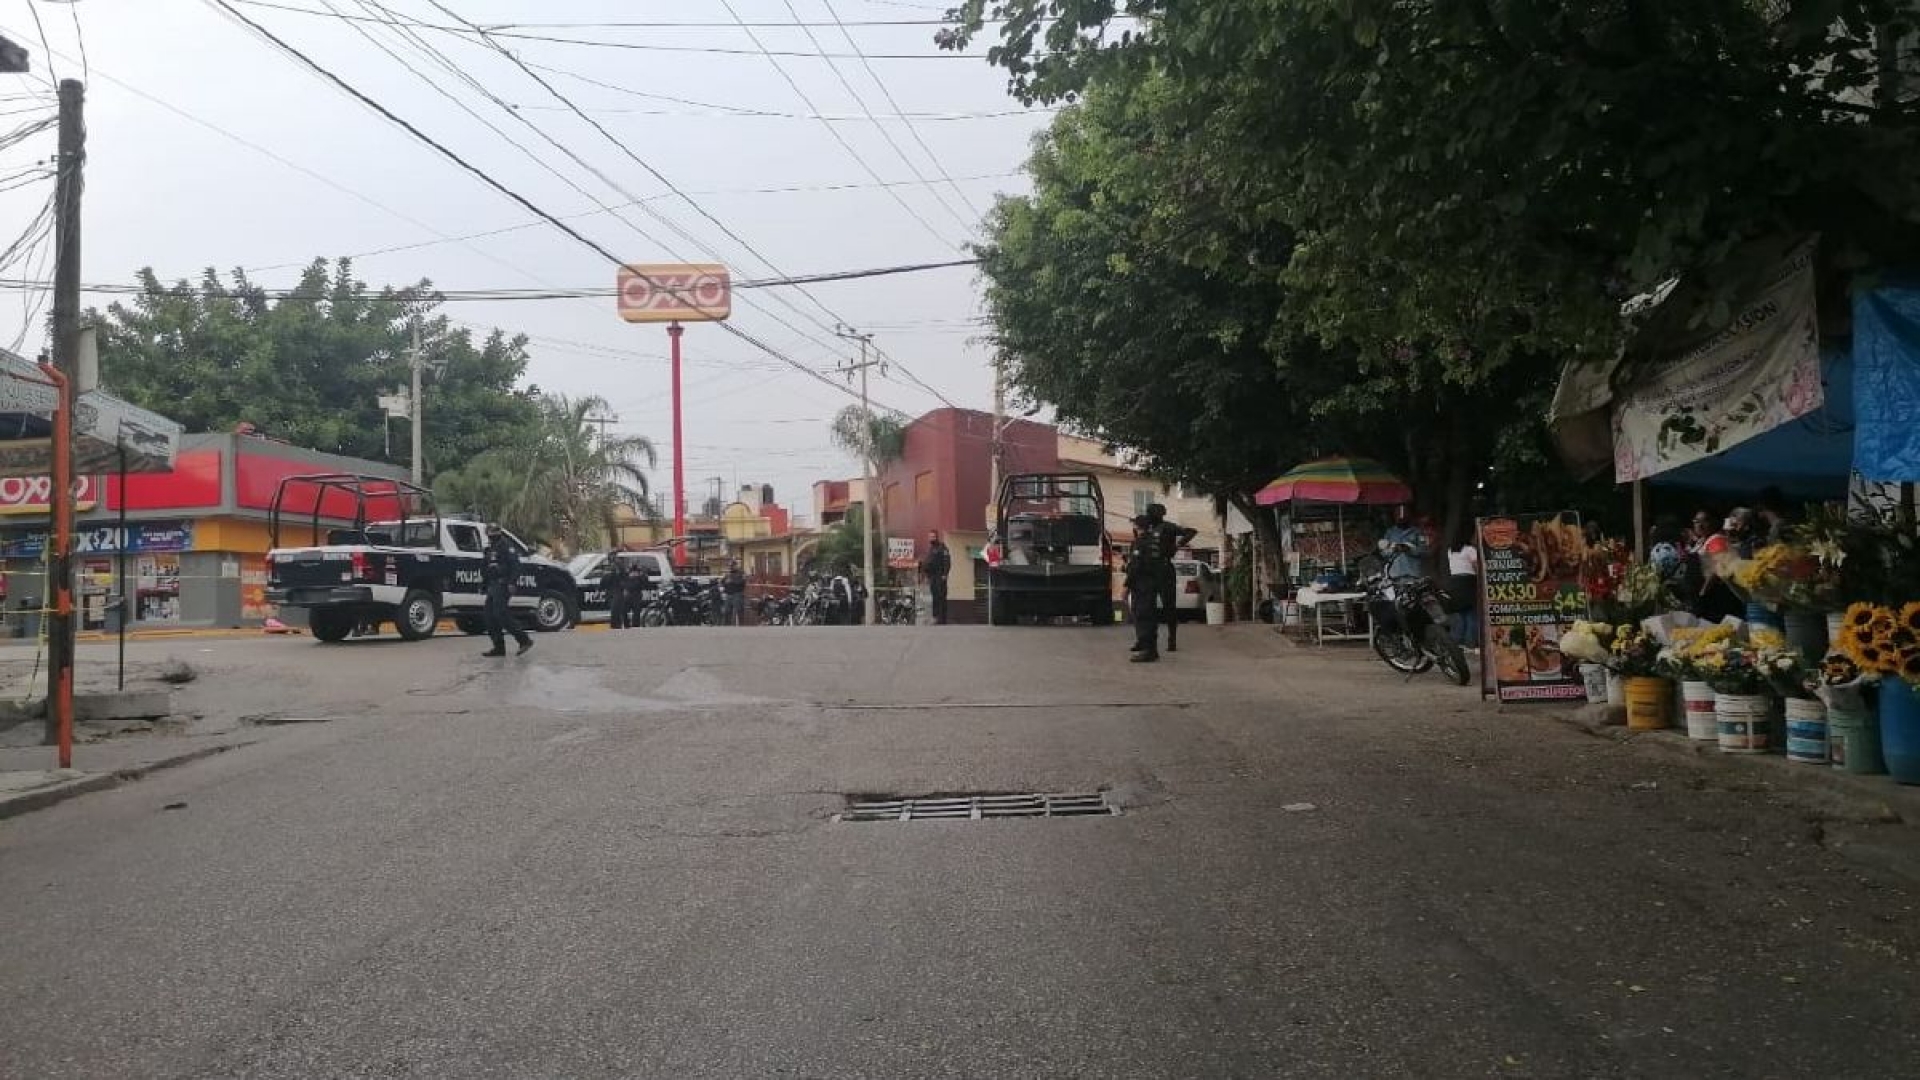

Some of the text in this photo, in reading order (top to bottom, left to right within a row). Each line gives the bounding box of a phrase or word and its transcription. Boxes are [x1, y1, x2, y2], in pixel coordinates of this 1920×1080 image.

[623, 275, 724, 308] OXXO
[1487, 584, 1537, 600] 3X$30
[1554, 590, 1586, 611] $45
